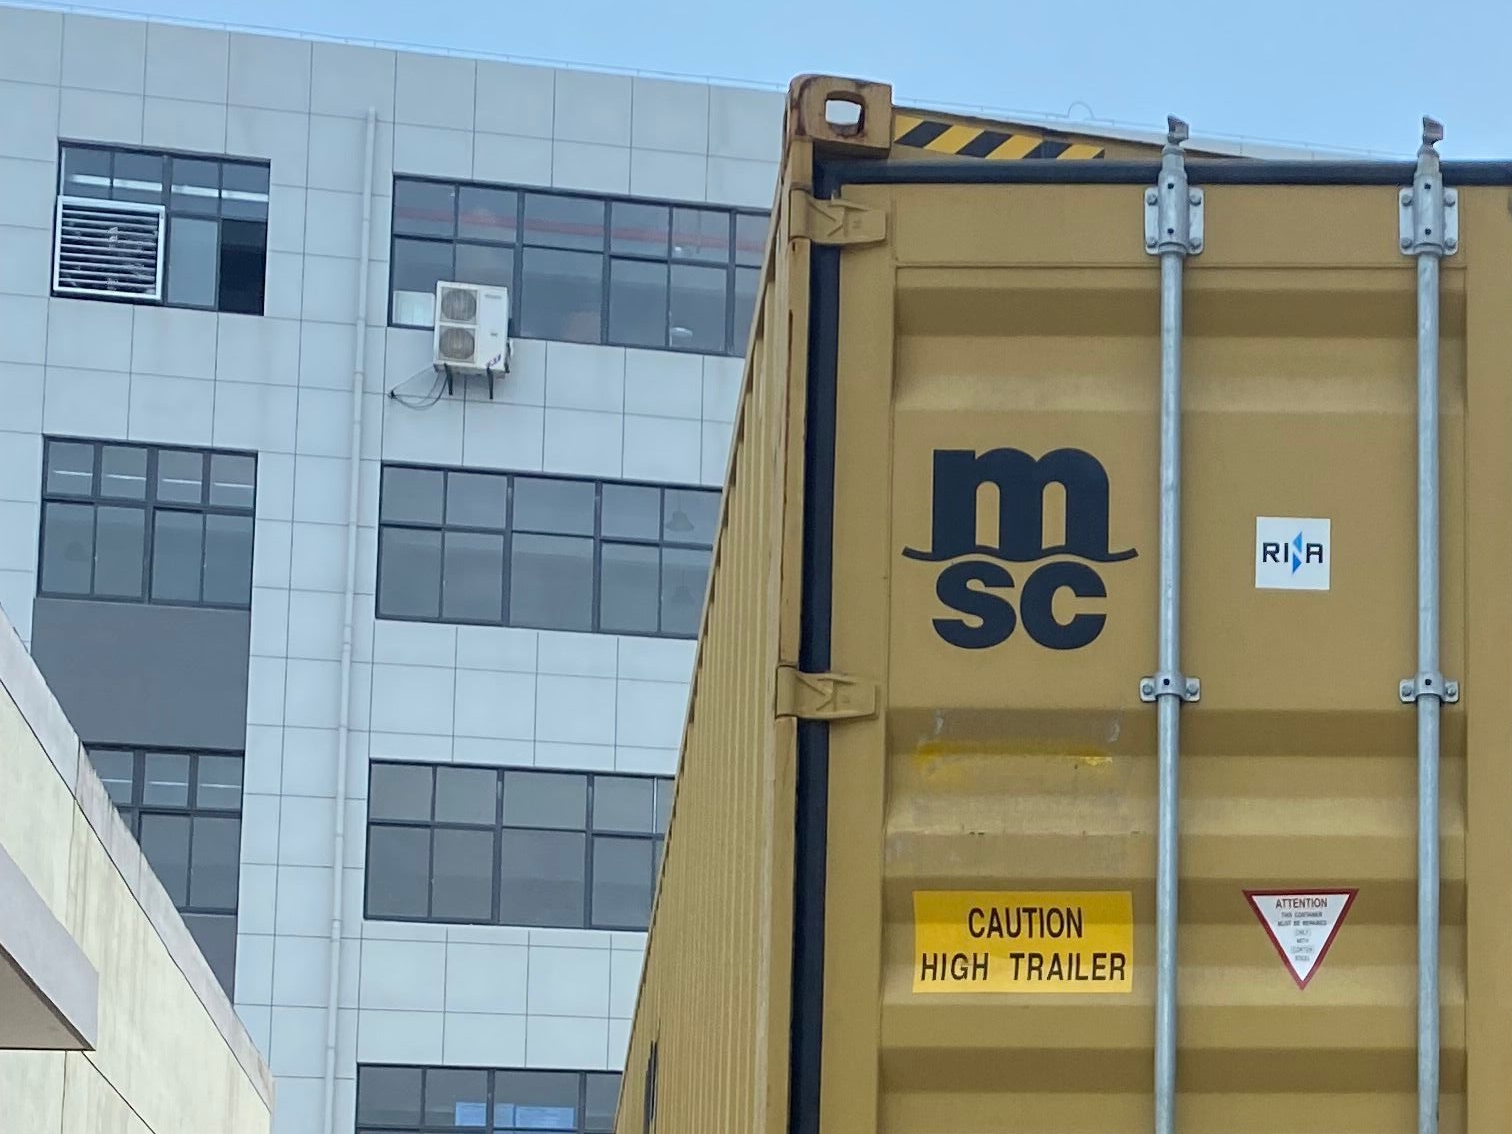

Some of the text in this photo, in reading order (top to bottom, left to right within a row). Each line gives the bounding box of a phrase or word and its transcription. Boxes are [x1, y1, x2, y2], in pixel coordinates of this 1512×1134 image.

[1275, 898, 1328, 909] ATTENTION
[968, 907, 1084, 939] CAUTION
[920, 952, 1127, 982] HIGH TRAILER
